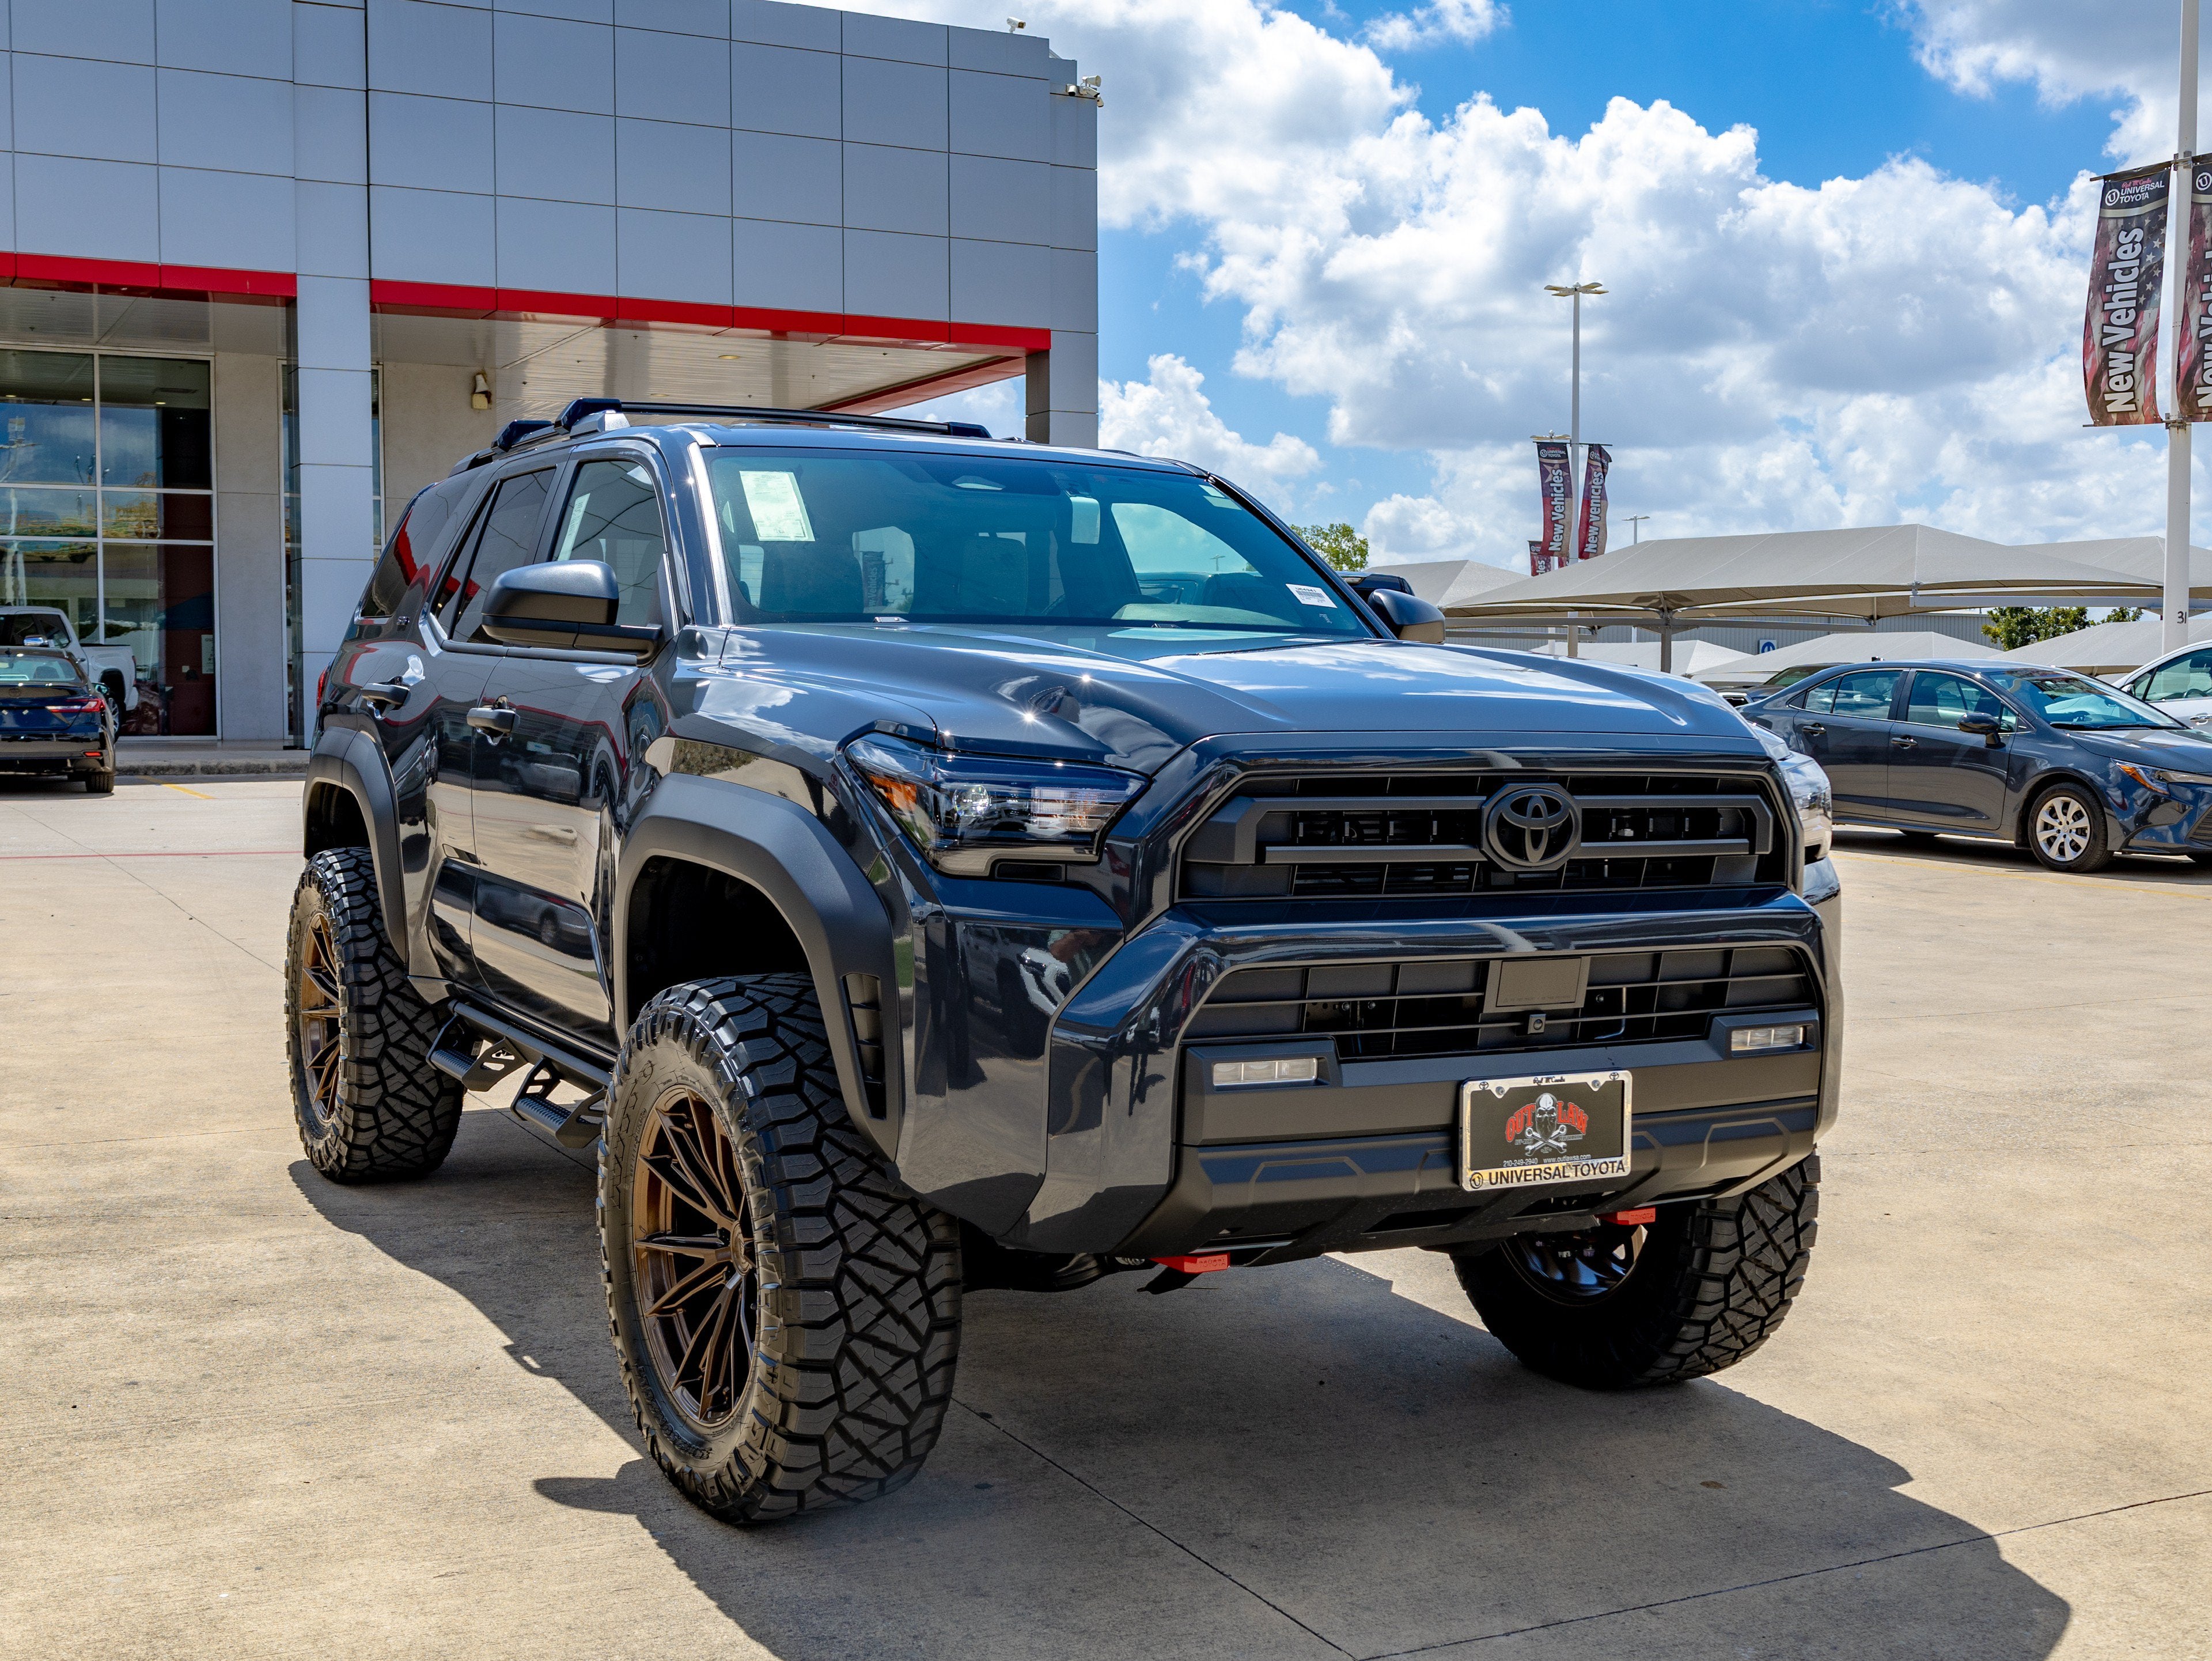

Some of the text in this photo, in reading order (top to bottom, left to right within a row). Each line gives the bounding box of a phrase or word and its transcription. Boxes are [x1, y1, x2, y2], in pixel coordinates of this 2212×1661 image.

[2120, 180, 2165, 195] UNIVERSAL
[2120, 192, 2149, 203] TOYOTA
[2102, 228, 2145, 413] New Vehicles
[1548, 469, 1565, 551] New Vehicles
[1585, 525, 1600, 553] New
[2177, 611, 2187, 624] 31
[1503, 1154, 1591, 1167] 210-249-2940 www.outlawsa.com
[1488, 1167, 1570, 1186] UNIVERSAL
[1572, 1160, 1626, 1177] TOYOTA
